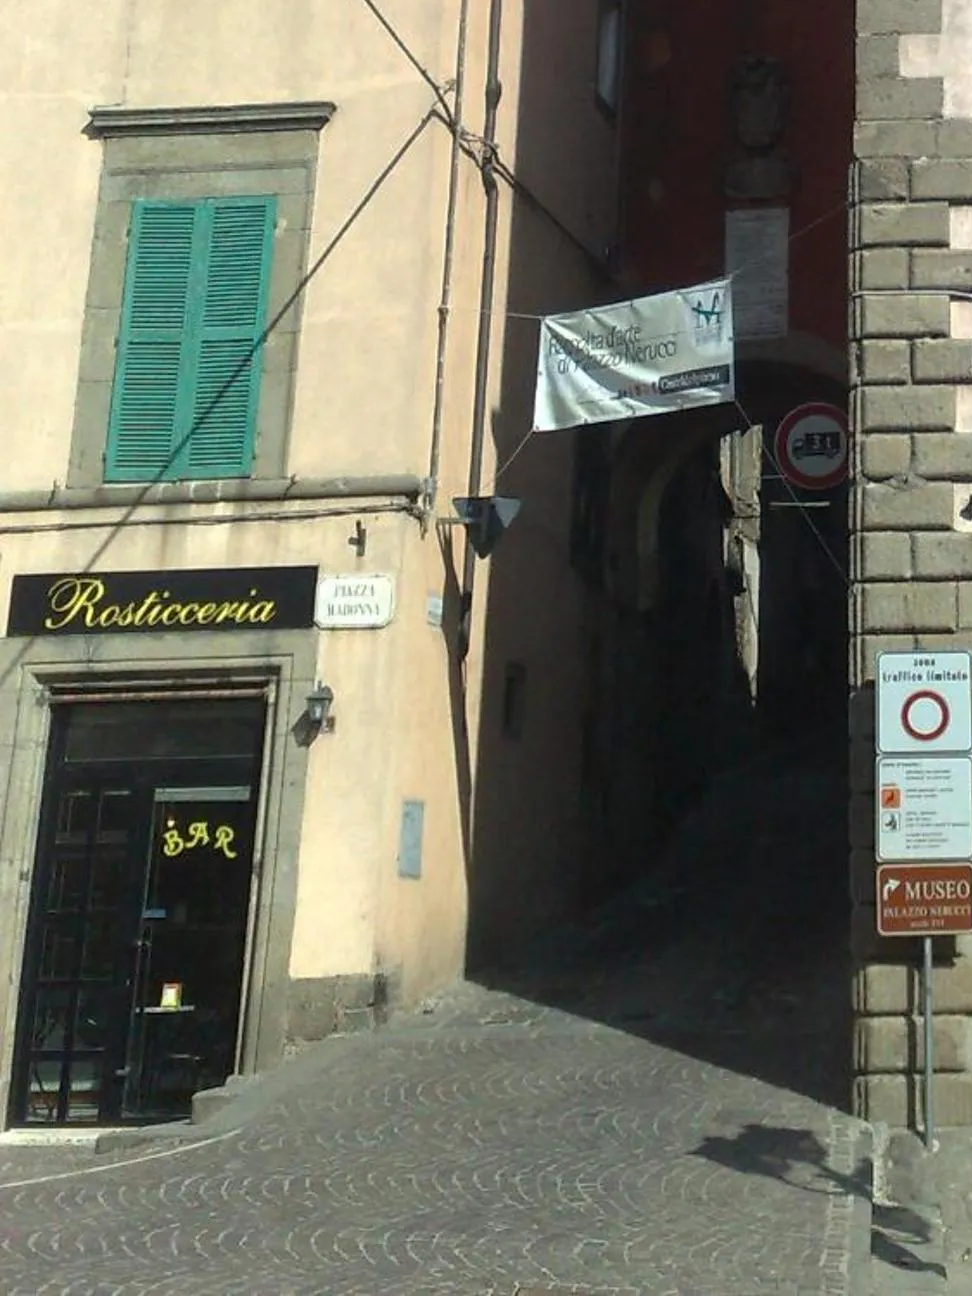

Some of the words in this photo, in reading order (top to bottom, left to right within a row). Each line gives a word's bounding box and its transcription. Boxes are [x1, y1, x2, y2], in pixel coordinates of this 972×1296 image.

[334, 583, 375, 598] PIAZZA
[45, 577, 276, 630] Rosticceria
[327, 602, 380, 617] MADONNA
[882, 670, 923, 683] traffico
[927, 669, 968, 682] limitato
[163, 821, 238, 859] BAR
[904, 879, 971, 900] MUSEO
[883, 906, 928, 918] PALAZZO
